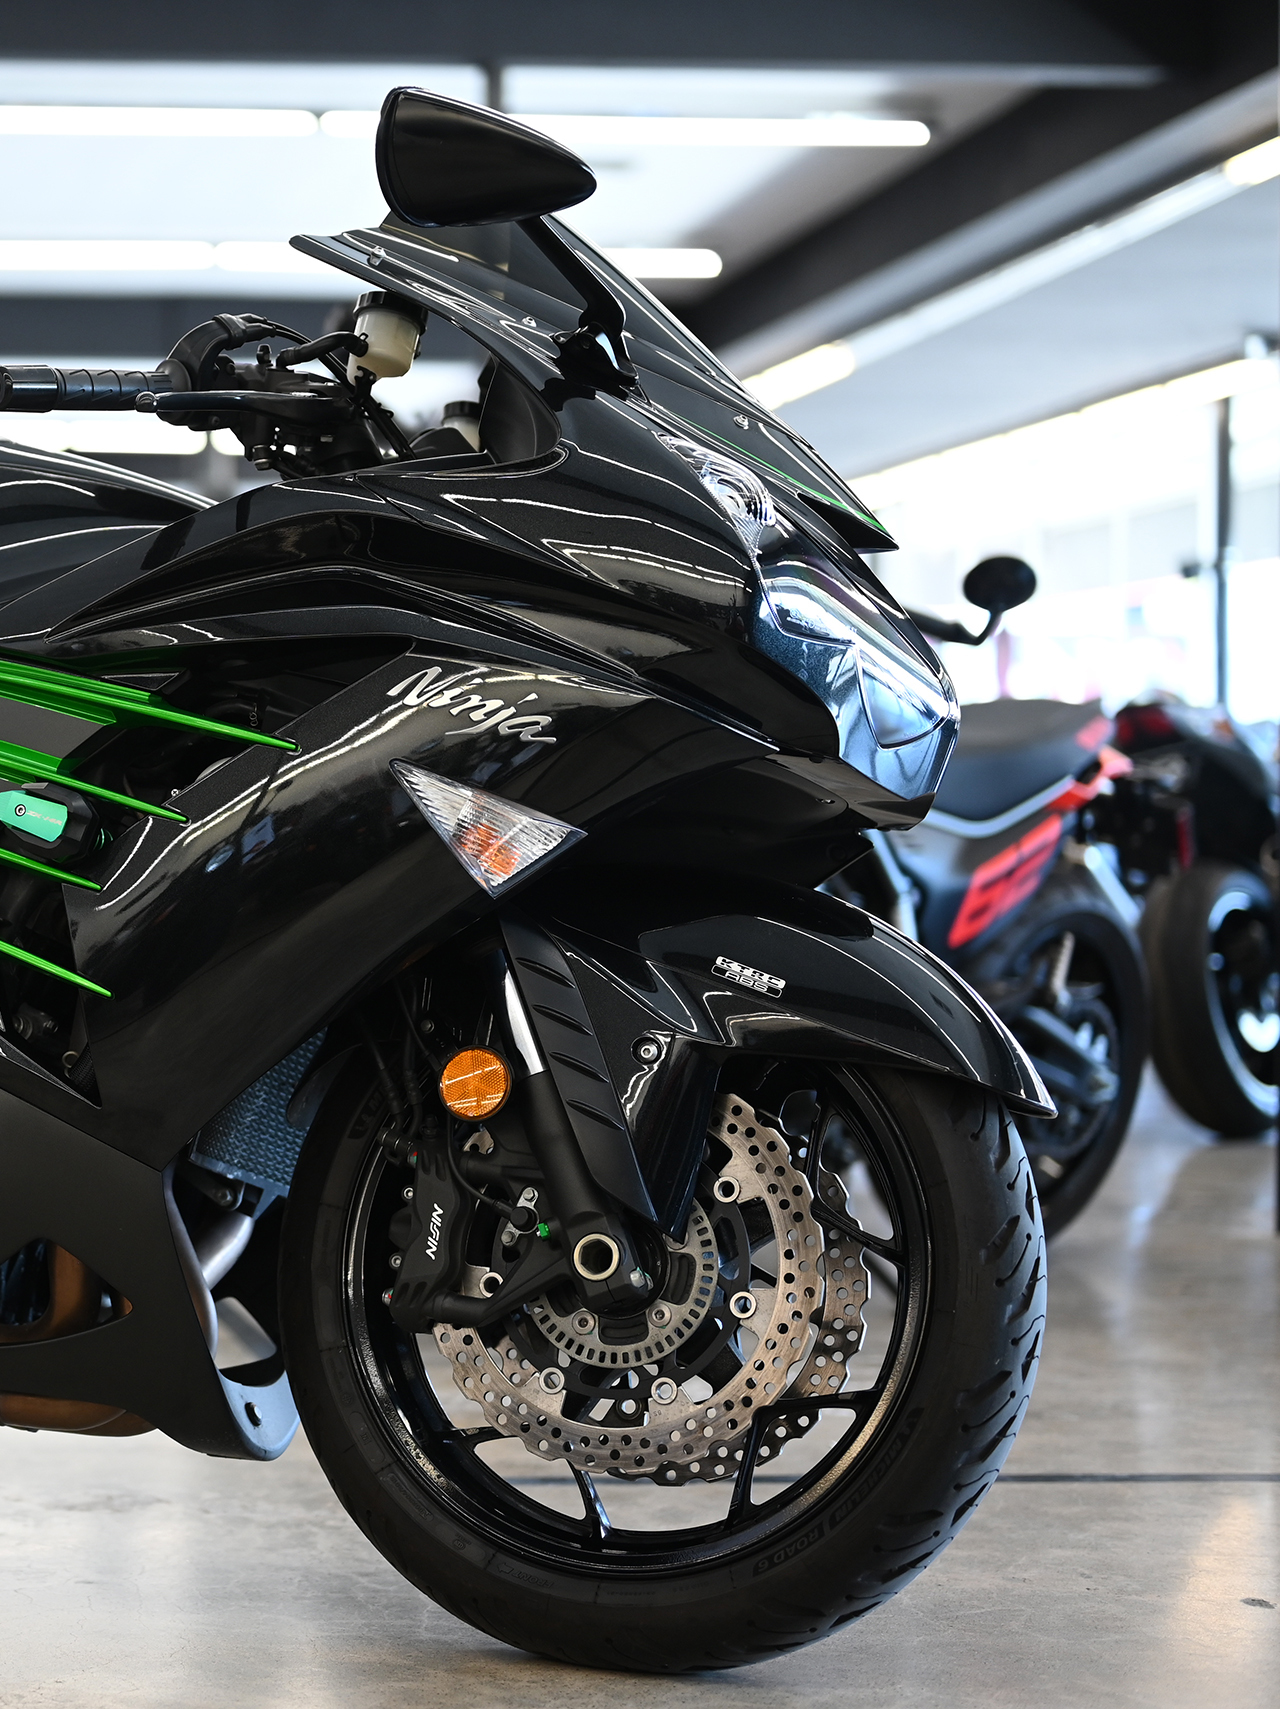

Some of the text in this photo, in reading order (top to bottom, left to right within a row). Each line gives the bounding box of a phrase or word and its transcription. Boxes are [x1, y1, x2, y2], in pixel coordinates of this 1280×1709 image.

[386, 665, 557, 744] Ninja
[719, 958, 781, 987] KTRC
[725, 970, 769, 993] ABS
[833, 1437, 903, 1522] MICHELIN
[757, 1529, 819, 1572] ROAD 6
[512, 1571, 555, 1589] FRONT
